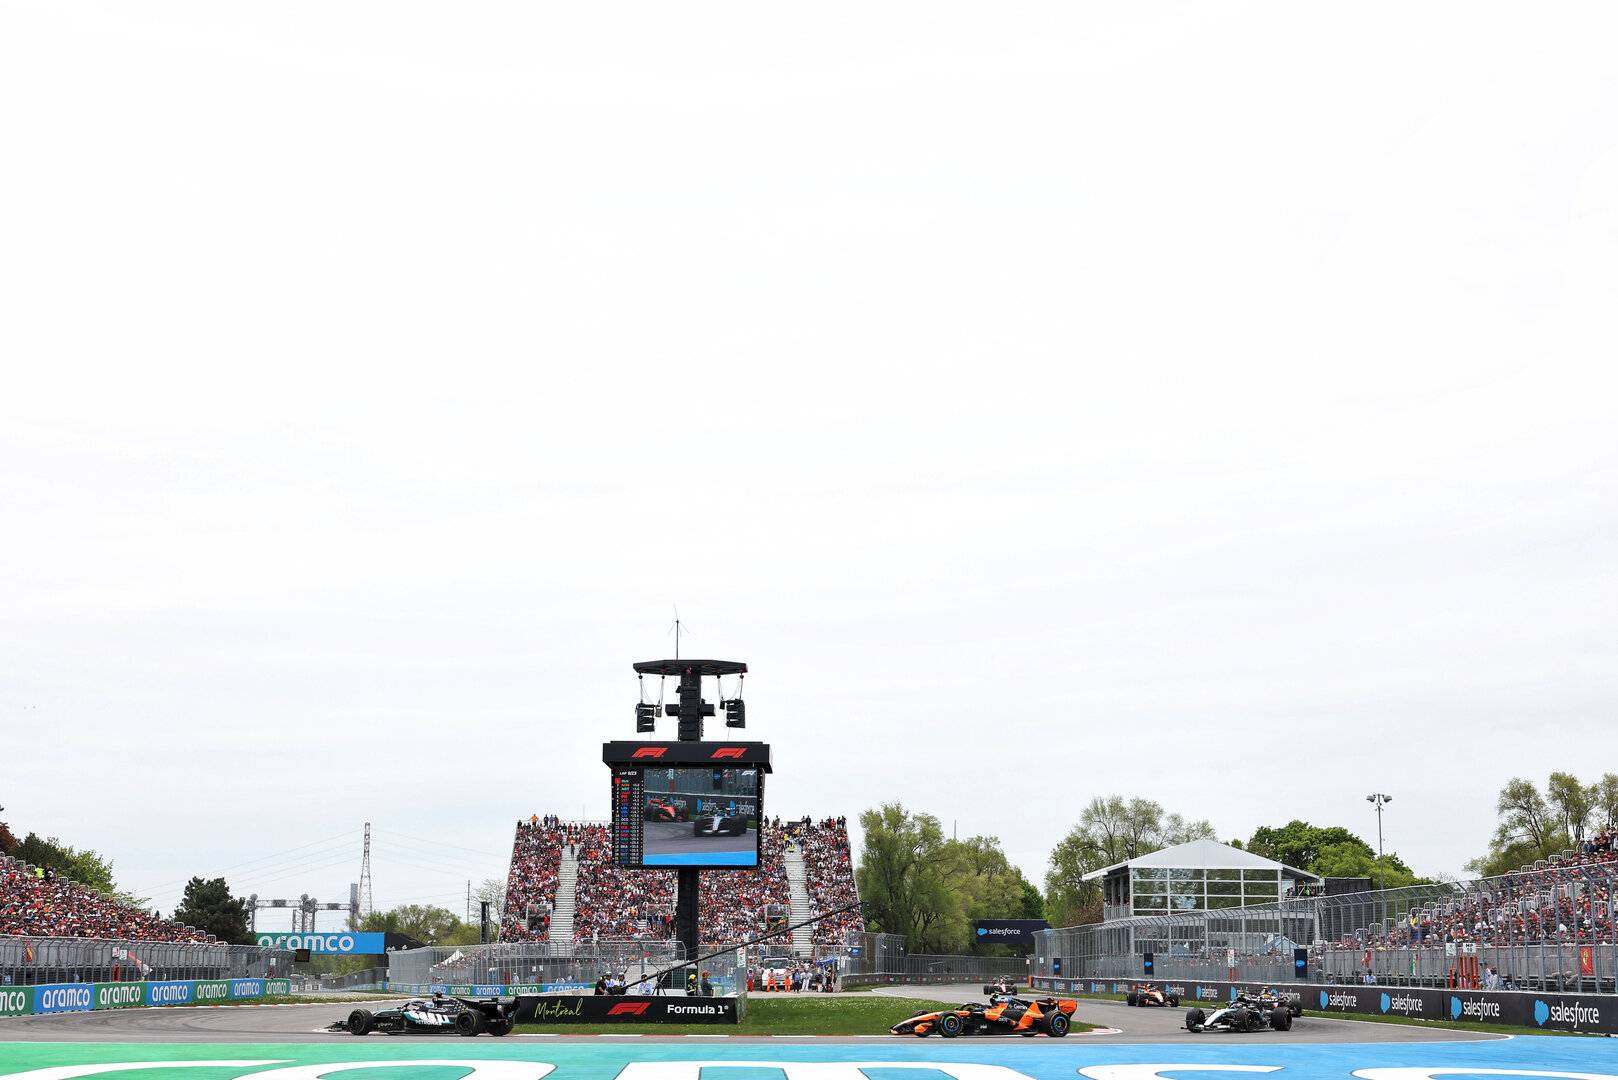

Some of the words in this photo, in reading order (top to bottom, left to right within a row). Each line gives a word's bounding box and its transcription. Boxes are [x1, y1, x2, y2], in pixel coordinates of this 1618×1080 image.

[988, 927, 1021, 937] salesforce
[257, 935, 355, 952] aramco
[99, 985, 141, 1005] aramco
[151, 985, 188, 1002] aramco
[196, 983, 227, 999] aramco
[234, 982, 260, 996] aramco
[266, 981, 287, 995] aramco
[451, 986, 471, 995] aramco
[475, 986, 501, 995] aramco
[508, 986, 538, 995] aramco
[1201, 985, 1218, 1001] salesforce
[42, 988, 91, 1009] aramco
[1329, 991, 1357, 1010] salesforce
[1391, 993, 1423, 1015] salesforce
[667, 1004, 715, 1014] Formula
[1463, 997, 1500, 1021] salesforce
[1550, 1001, 1600, 1028] salesforce
